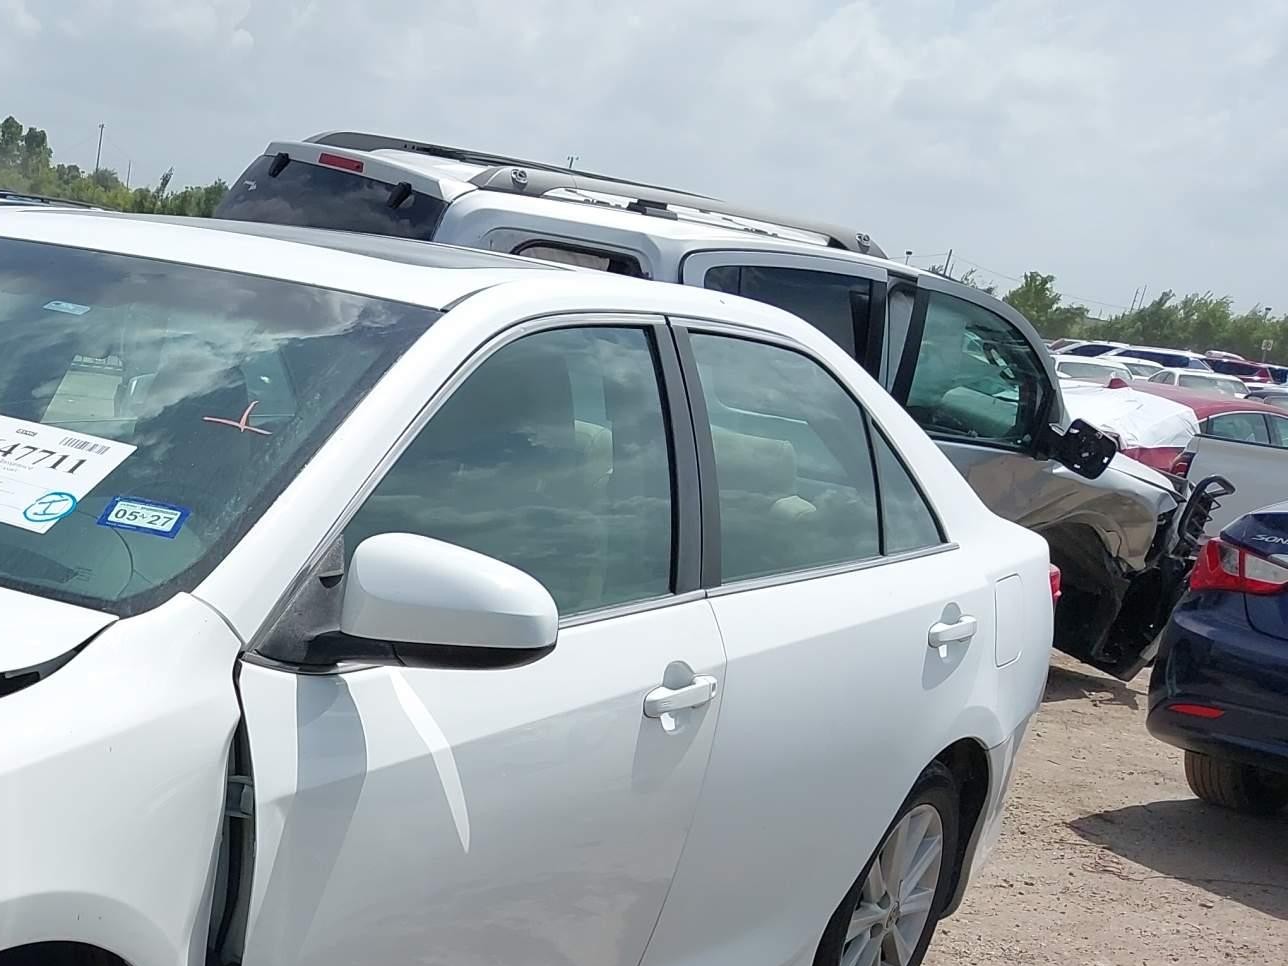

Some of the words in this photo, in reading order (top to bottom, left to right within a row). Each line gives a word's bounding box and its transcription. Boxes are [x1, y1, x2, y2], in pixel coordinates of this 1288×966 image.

[114, 508, 139, 522] 05
[146, 514, 175, 528] 27
[1251, 534, 1288, 545] SON
